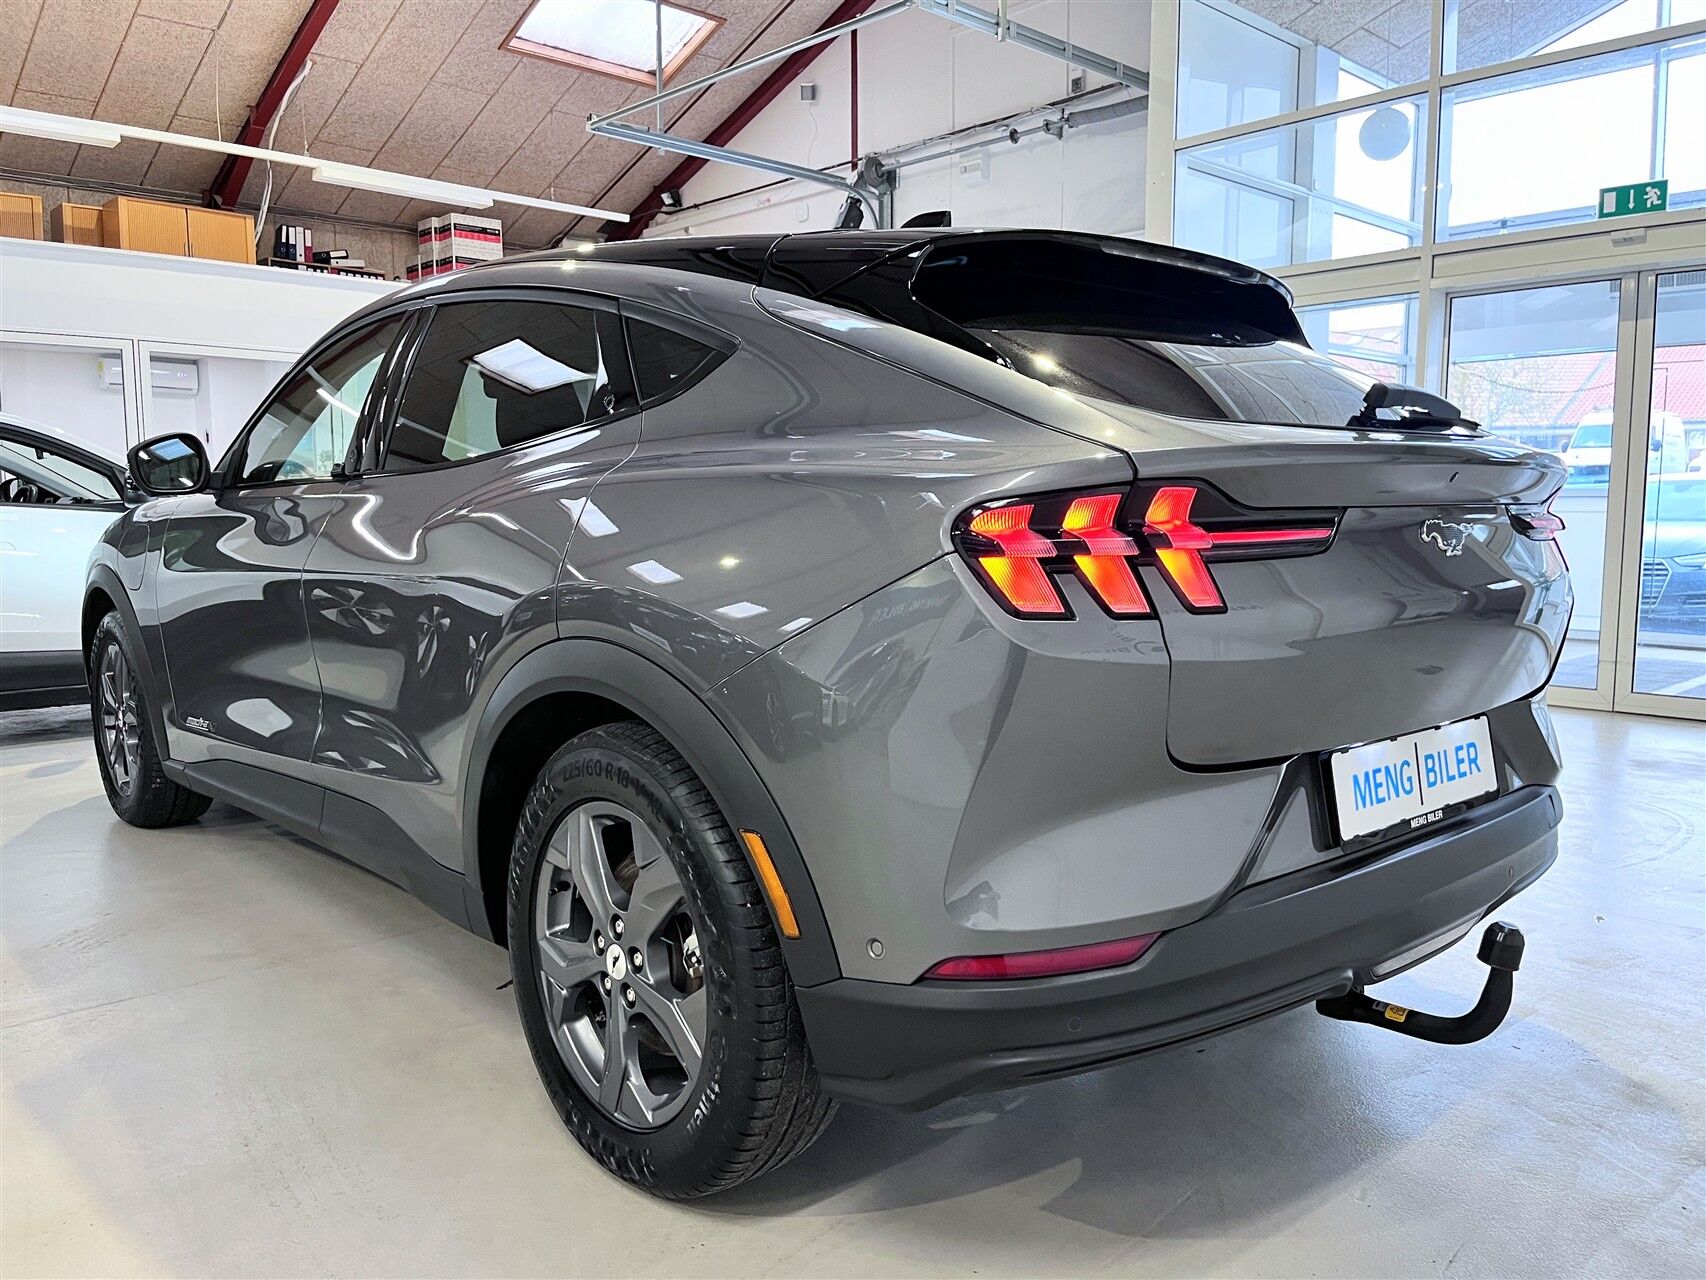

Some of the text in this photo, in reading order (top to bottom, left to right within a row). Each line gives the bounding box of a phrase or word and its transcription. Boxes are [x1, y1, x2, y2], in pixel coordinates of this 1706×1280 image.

[563, 757, 602, 782] 225/60
[605, 762, 614, 781] R
[616, 767, 630, 788] 18
[1352, 741, 1481, 811] MENG BILER
[1410, 810, 1443, 828] MENG BILER
